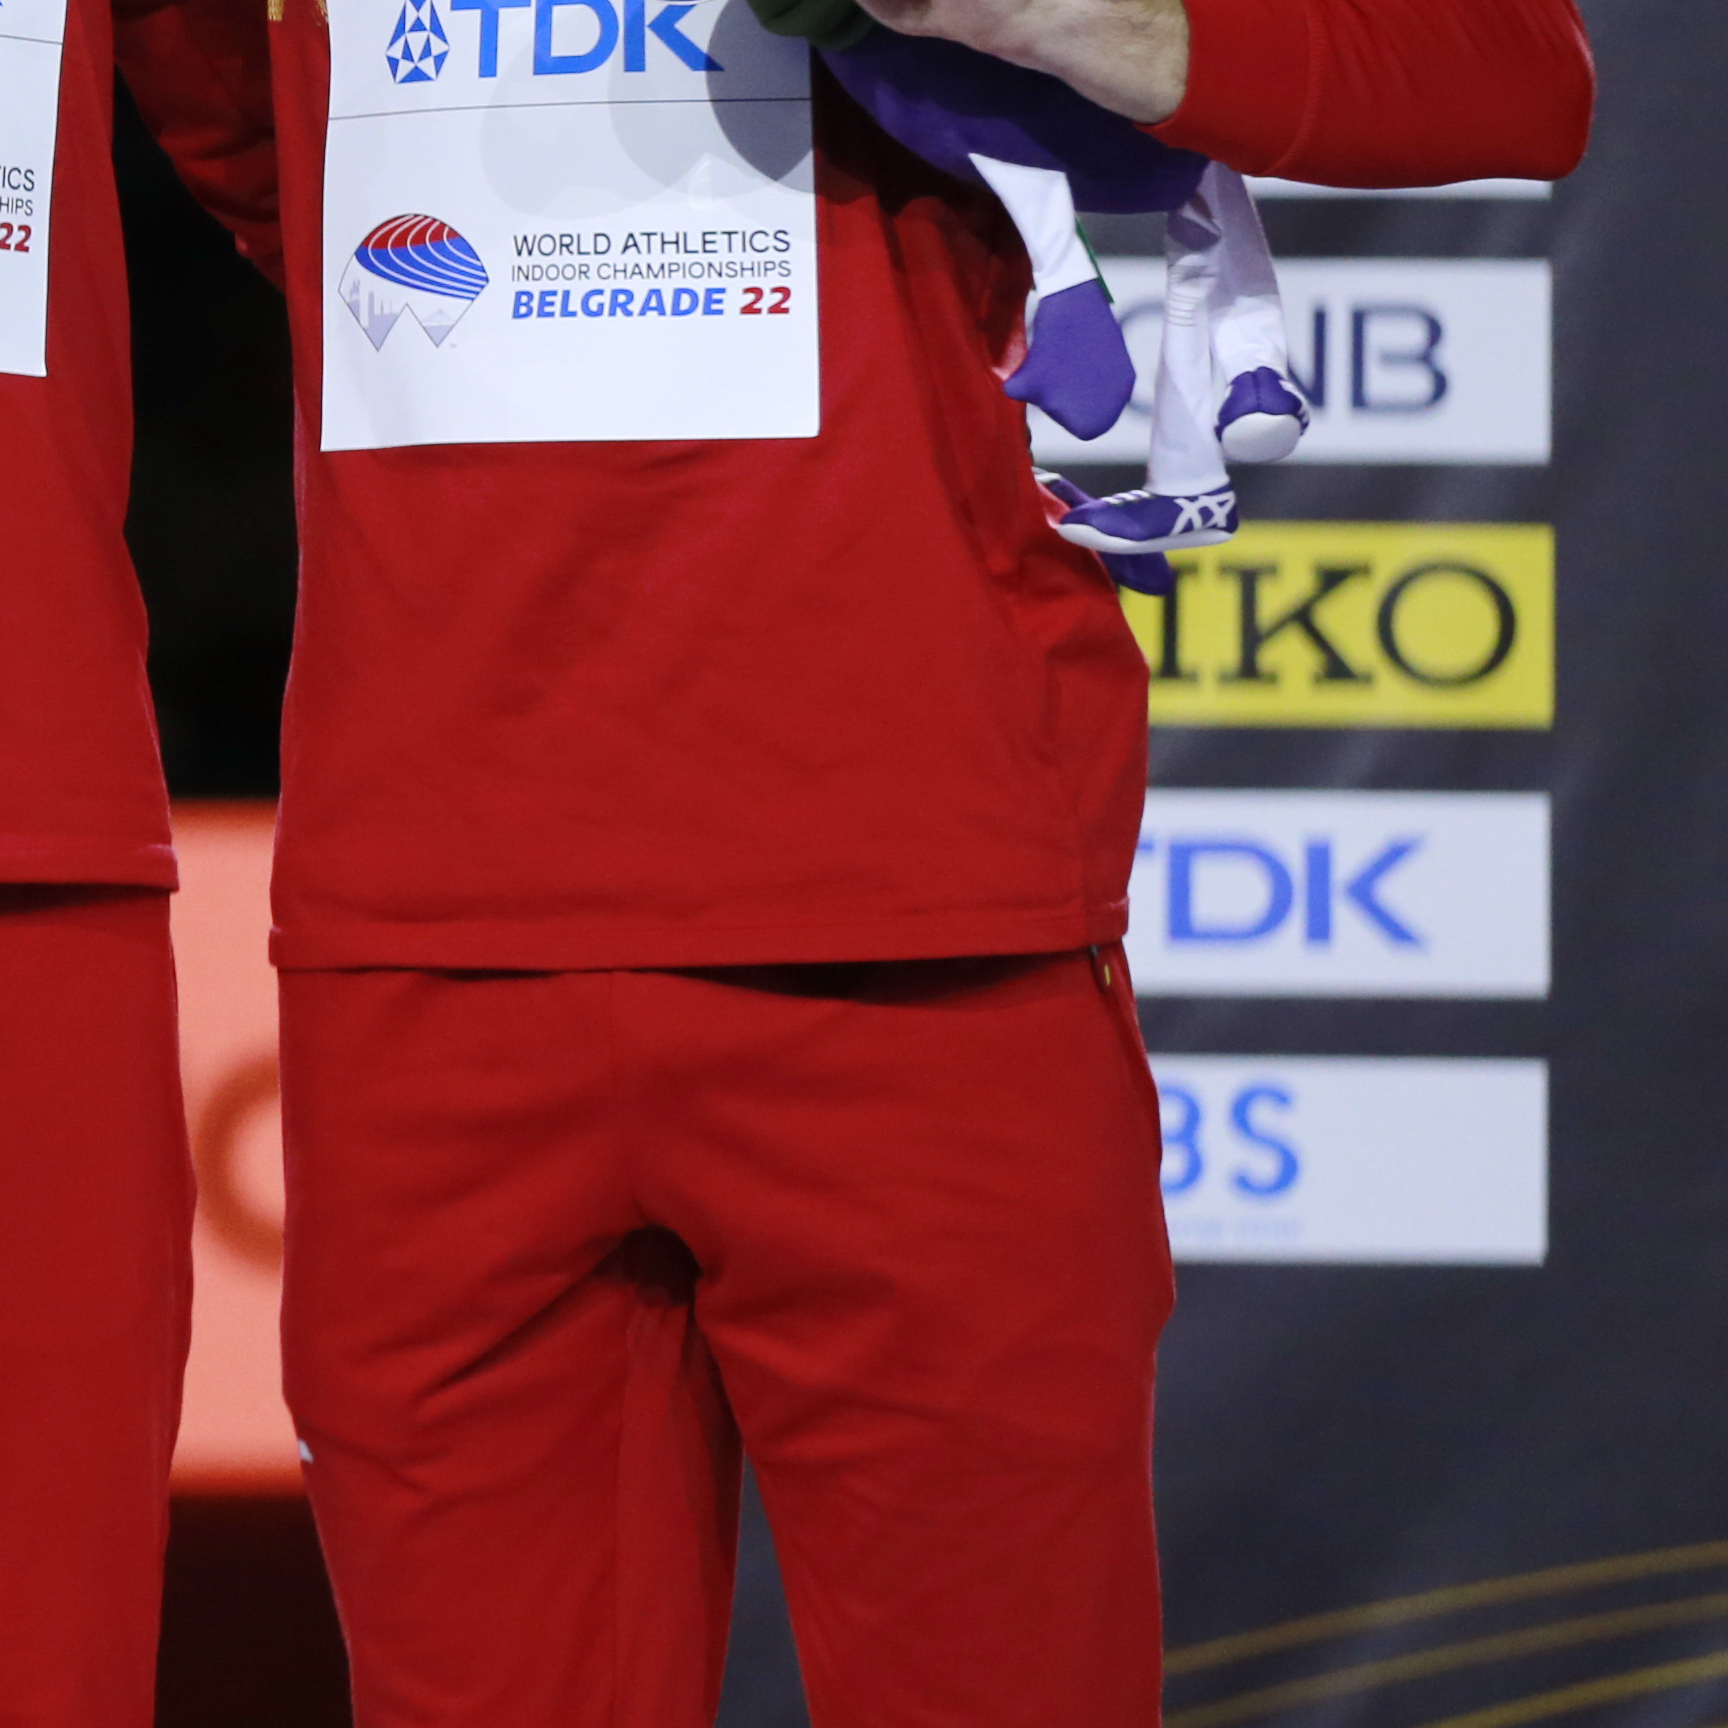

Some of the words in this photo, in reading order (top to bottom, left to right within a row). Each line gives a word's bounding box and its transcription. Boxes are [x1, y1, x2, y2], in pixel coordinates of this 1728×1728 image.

[511, 262, 590, 283] INDOOR
[596, 260, 792, 281] CHAMPIONSHIPS
[513, 232, 612, 257] WORLD
[621, 229, 791, 255] ATHLETICS
[512, 287, 727, 320] BELGRADE
[740, 286, 792, 315] 22
[1152, 560, 1518, 689] IKO
[1139, 835, 1430, 949] DK
[1158, 1082, 1301, 1199] BS
